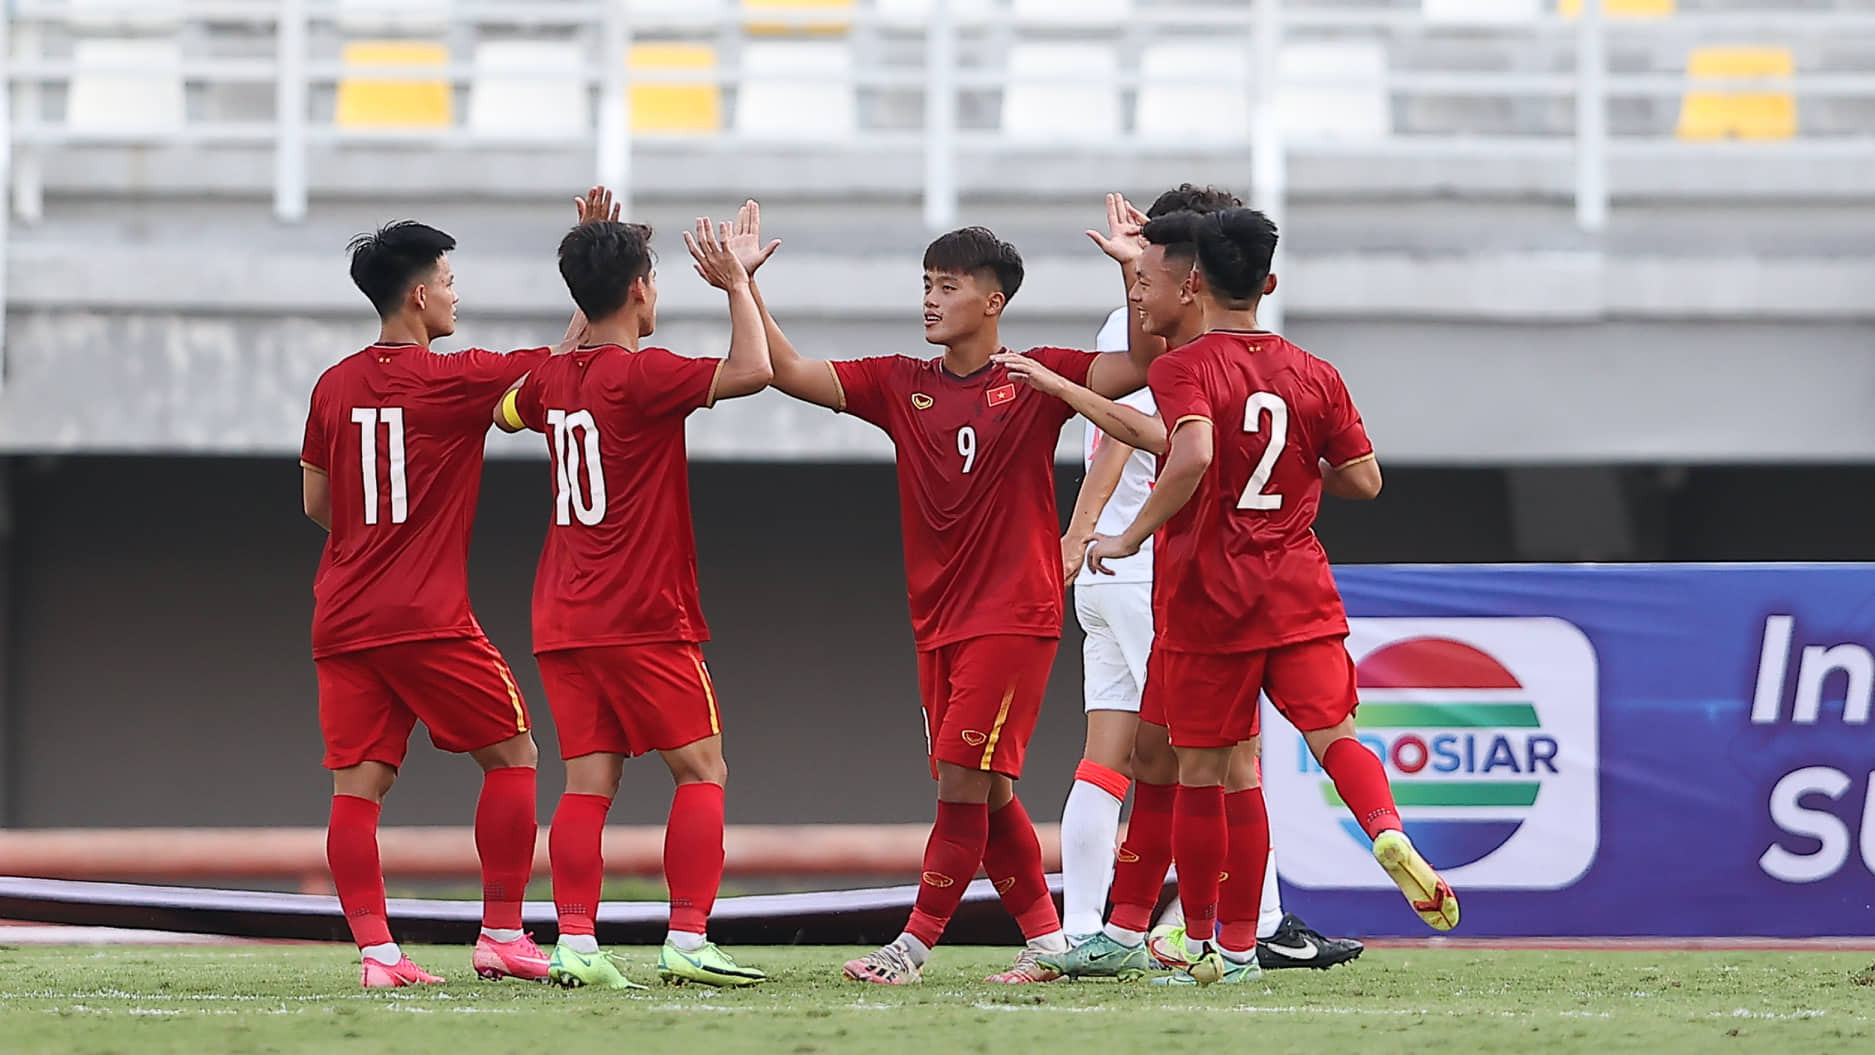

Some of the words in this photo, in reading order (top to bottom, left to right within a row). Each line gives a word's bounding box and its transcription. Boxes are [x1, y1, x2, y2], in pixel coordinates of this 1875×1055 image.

[351, 407, 408, 525] 11
[547, 409, 607, 526] 10
[957, 426, 976, 473] 9
[1236, 391, 1288, 510] 2
[1759, 766, 1875, 882] S
